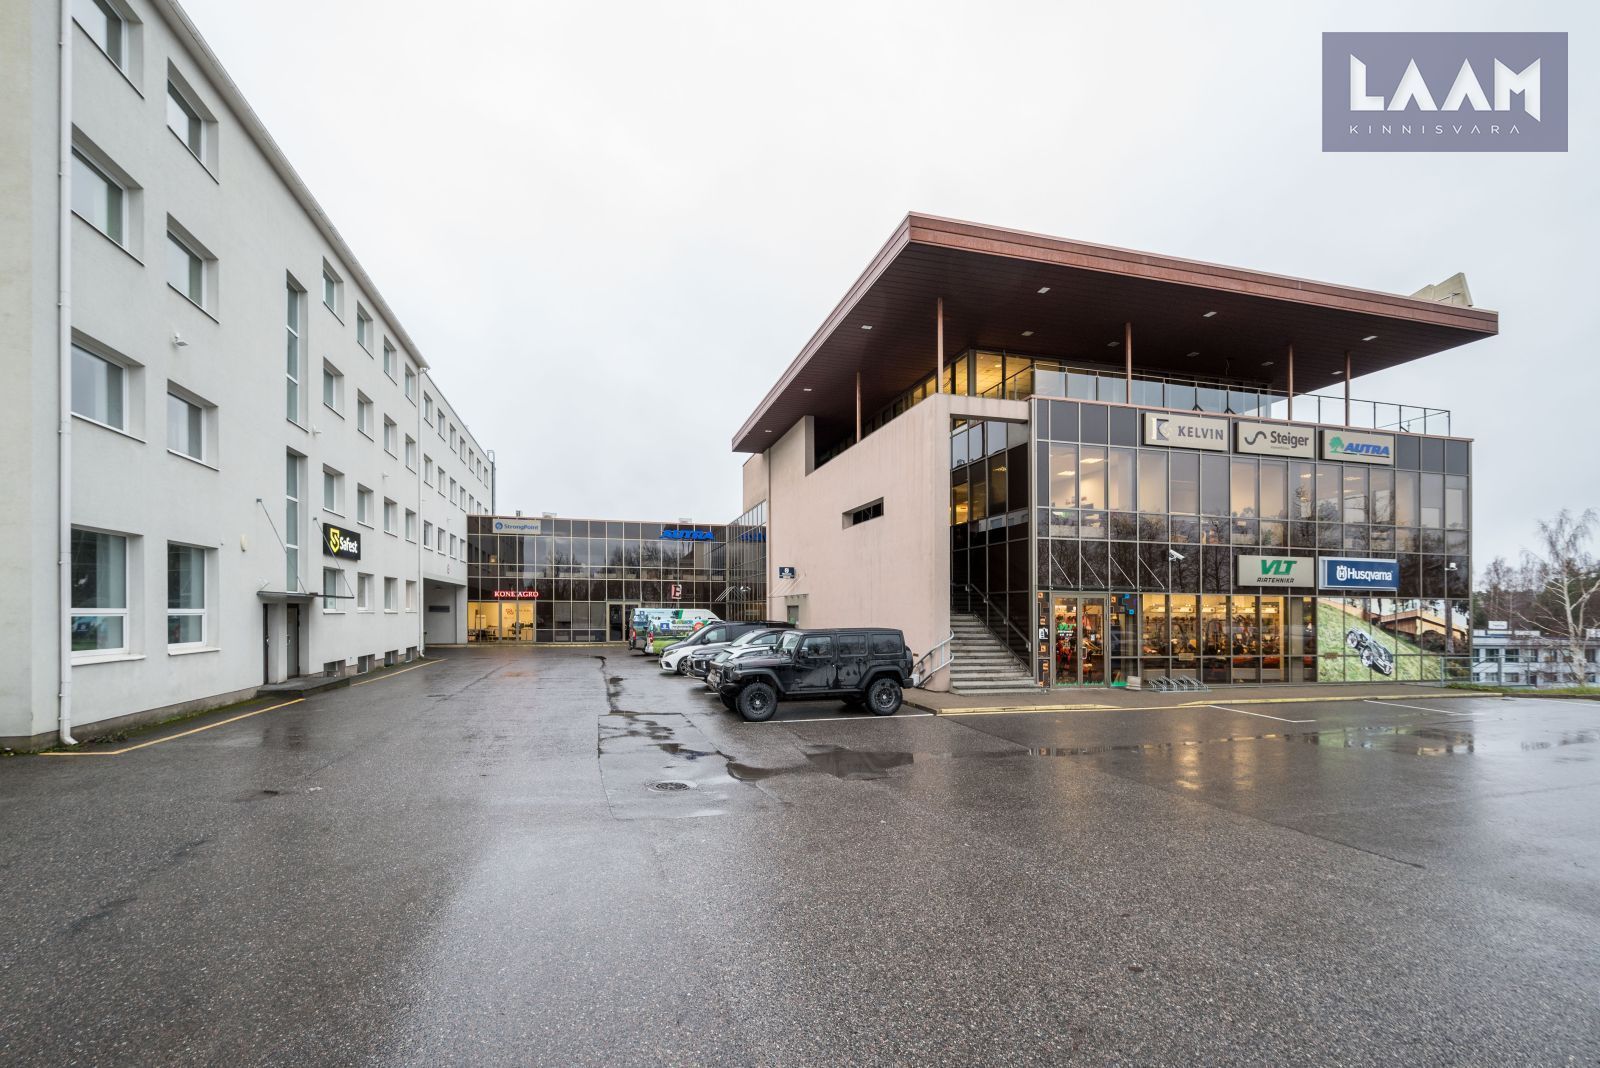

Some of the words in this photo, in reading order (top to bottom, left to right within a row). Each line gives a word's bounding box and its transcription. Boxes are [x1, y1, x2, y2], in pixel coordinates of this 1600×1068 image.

[1178, 425, 1224, 440] KELVIN
[1270, 430, 1310, 448] Steiger
[1343, 442, 1390, 456] AUTRA
[504, 523, 539, 531] StrongPoint
[339, 536, 358, 554] Safest
[1261, 559, 1298, 575] VLT
[1347, 567, 1393, 582] Husqvarna
